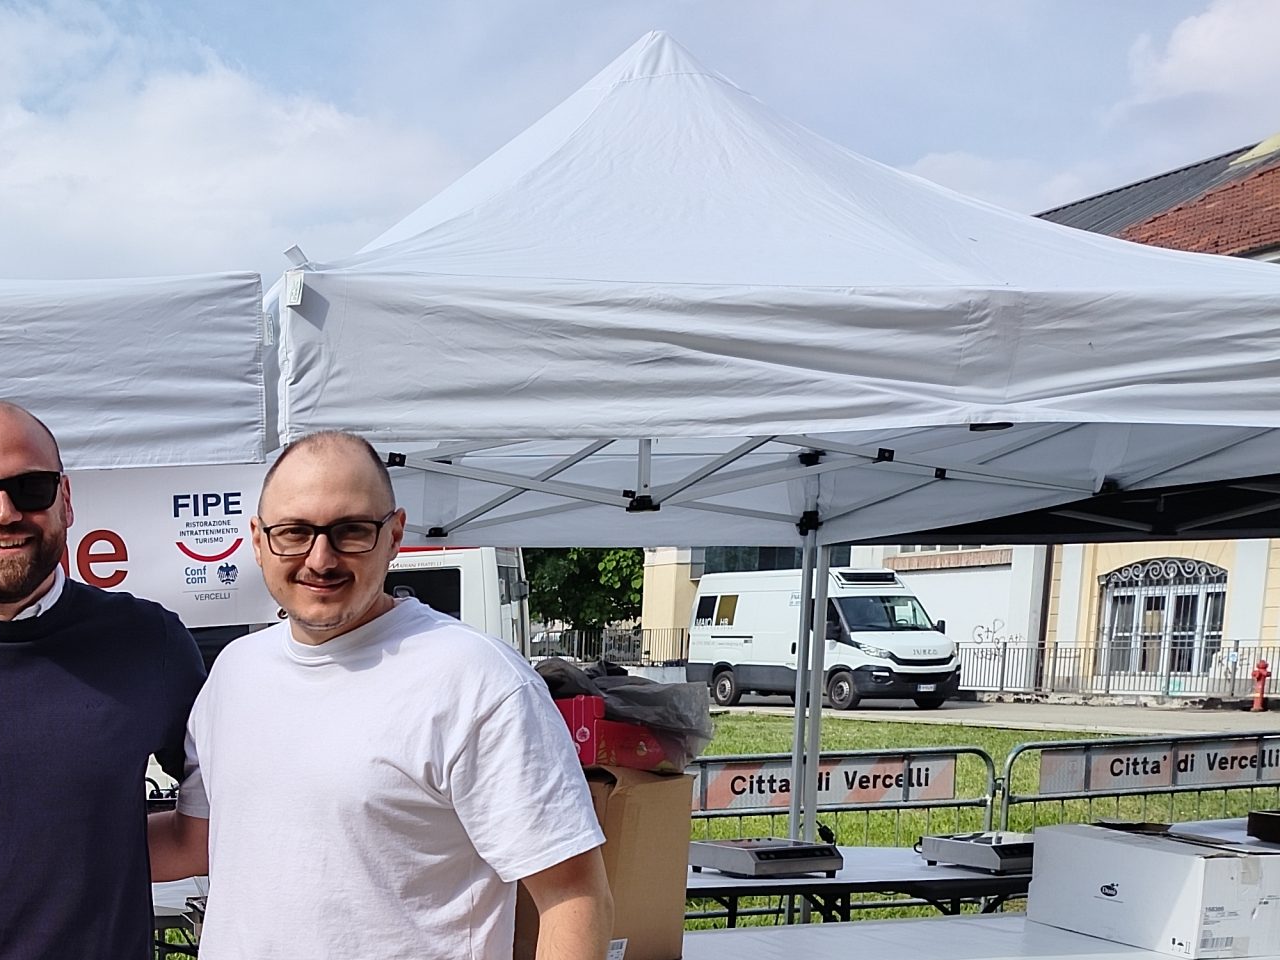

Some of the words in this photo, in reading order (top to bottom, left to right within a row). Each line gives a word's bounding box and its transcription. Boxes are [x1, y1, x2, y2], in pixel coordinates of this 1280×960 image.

[173, 492, 242, 518] FIPE
[185, 520, 232, 528] RISTORAZIONE
[179, 528, 239, 537] INTRATTENIMENTO
[184, 565, 207, 576] Conf
[186, 576, 207, 585] com
[194, 592, 231, 601] VERCELLI
[912, 648, 938, 656] IVECO
[1109, 754, 1168, 777] Citta'
[1176, 753, 1195, 773] di
[1206, 749, 1280, 771] Vercelli
[843, 766, 931, 790] Vercelli
